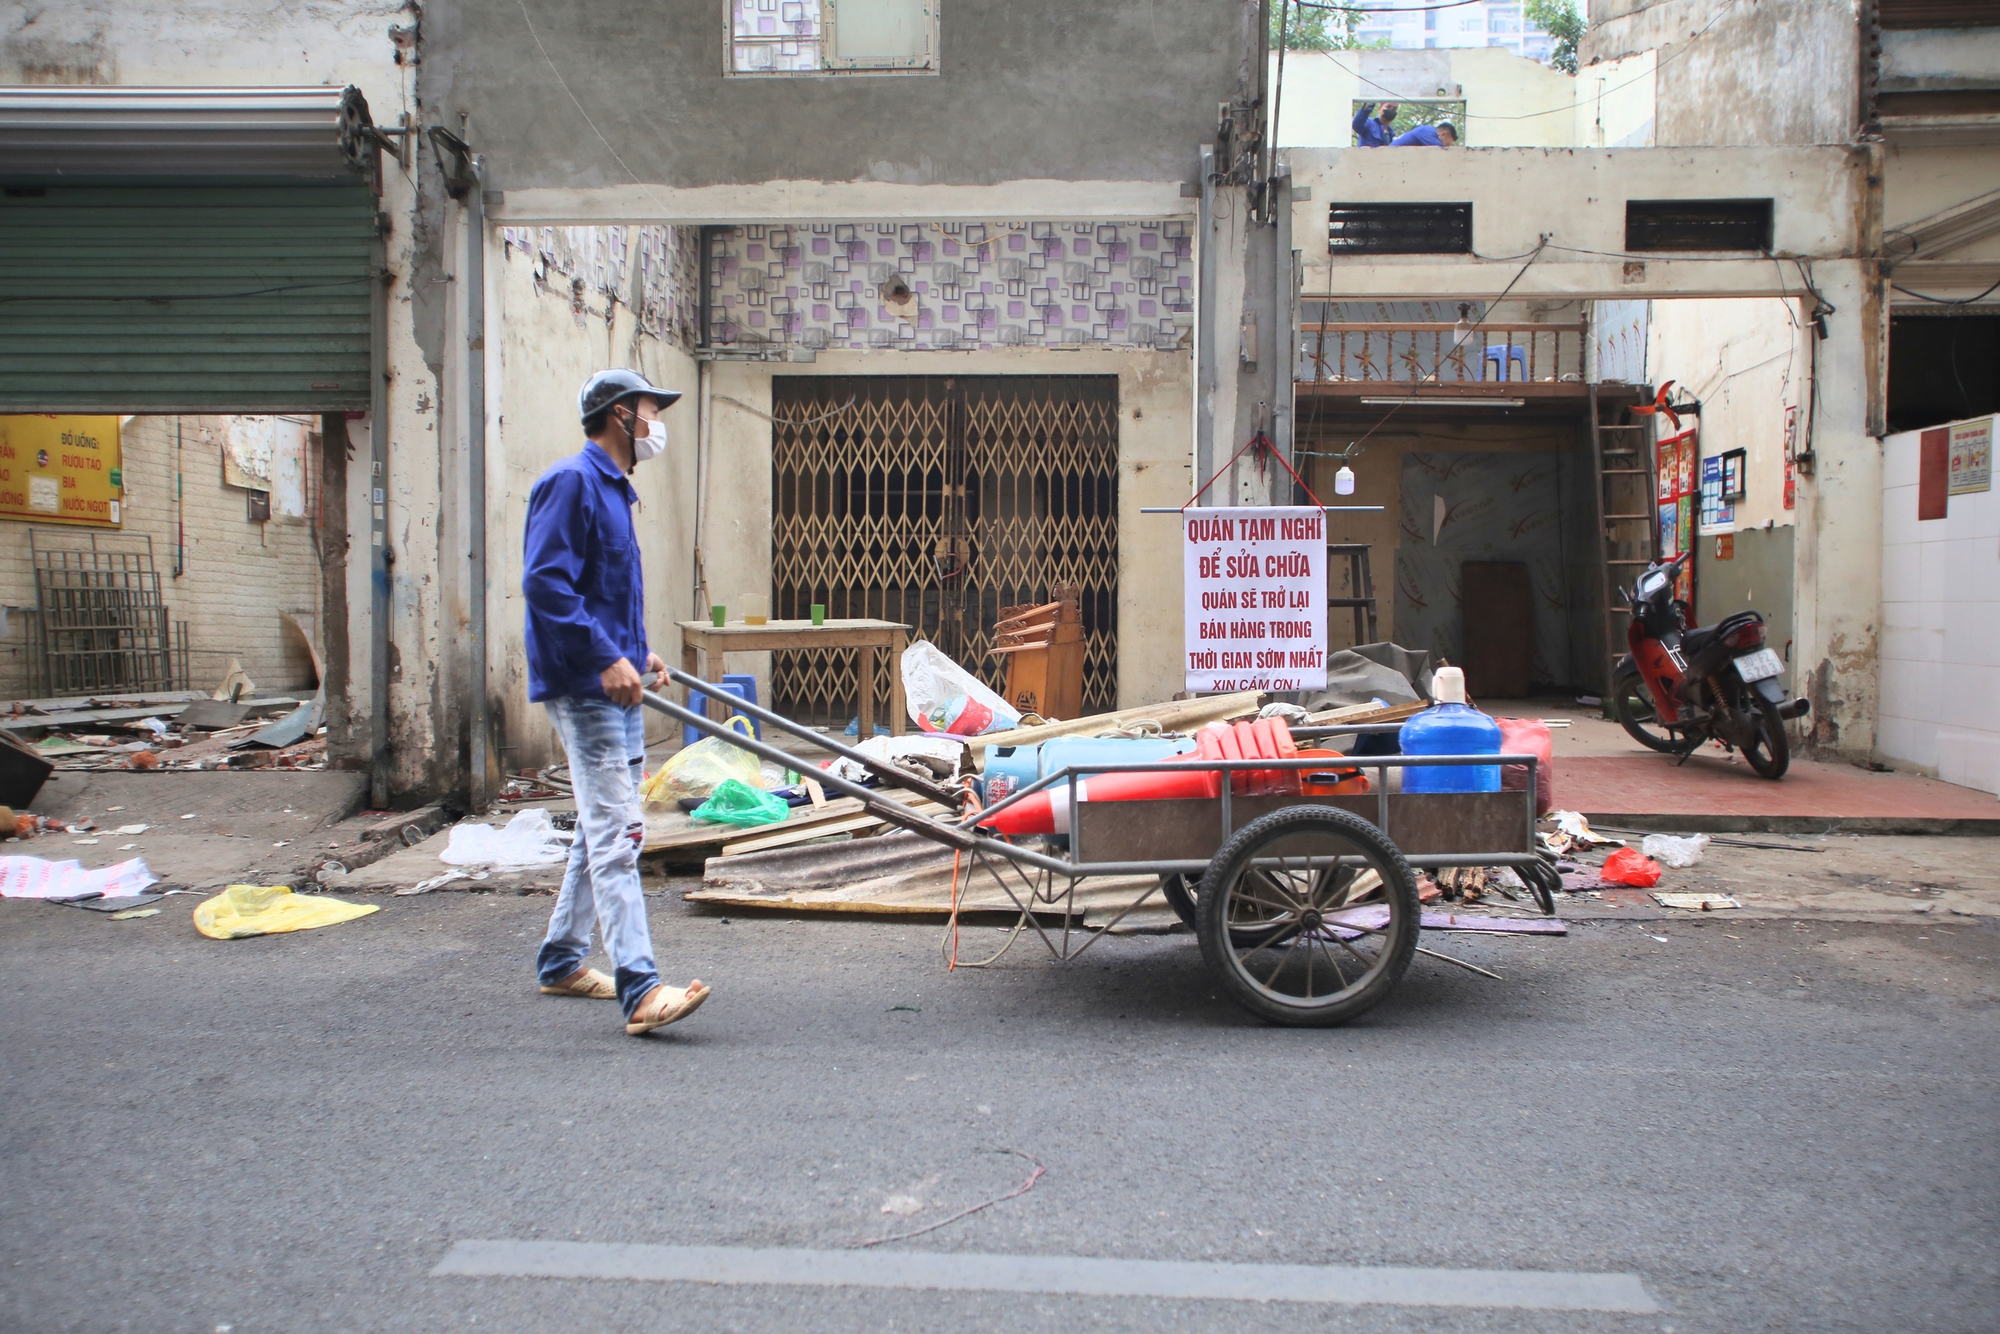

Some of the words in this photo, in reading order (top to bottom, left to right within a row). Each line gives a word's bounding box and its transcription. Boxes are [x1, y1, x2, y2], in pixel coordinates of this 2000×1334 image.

[61, 428, 73, 446] ĐỒ
[75, 431, 99, 450] UỐNG:
[62, 454, 84, 471] RƯỢU
[62, 476, 76, 489] BIA
[62, 495, 85, 511] NƯỚC
[87, 499, 108, 513] NGỌT
[1188, 514, 1234, 544] QUÁN
[1239, 518, 1275, 546] TẠM
[1281, 510, 1322, 540] NGHỈ
[1199, 547, 1222, 579] ĐỂ
[1226, 548, 1260, 578] SỬA
[1265, 550, 1311, 578] CHỮA
[1202, 588, 1237, 611] QUÁN
[1241, 588, 1257, 609] SẼ
[1261, 585, 1286, 609] TRỞ
[1289, 590, 1310, 612] LẠI
[1199, 618, 1227, 640] BÁN
[1230, 618, 1266, 639] HÀNG
[1269, 620, 1312, 639] TRONG
[1189, 648, 1218, 670] THỜI
[1222, 650, 1253, 669] GIAN
[1256, 647, 1285, 669] SỚM
[1289, 644, 1323, 669] NHẤT
[1212, 679, 1236, 690] XIN
[1239, 675, 1270, 690] CẢM
[1273, 678, 1294, 690] ƠN
[1295, 679, 1301, 690] !
